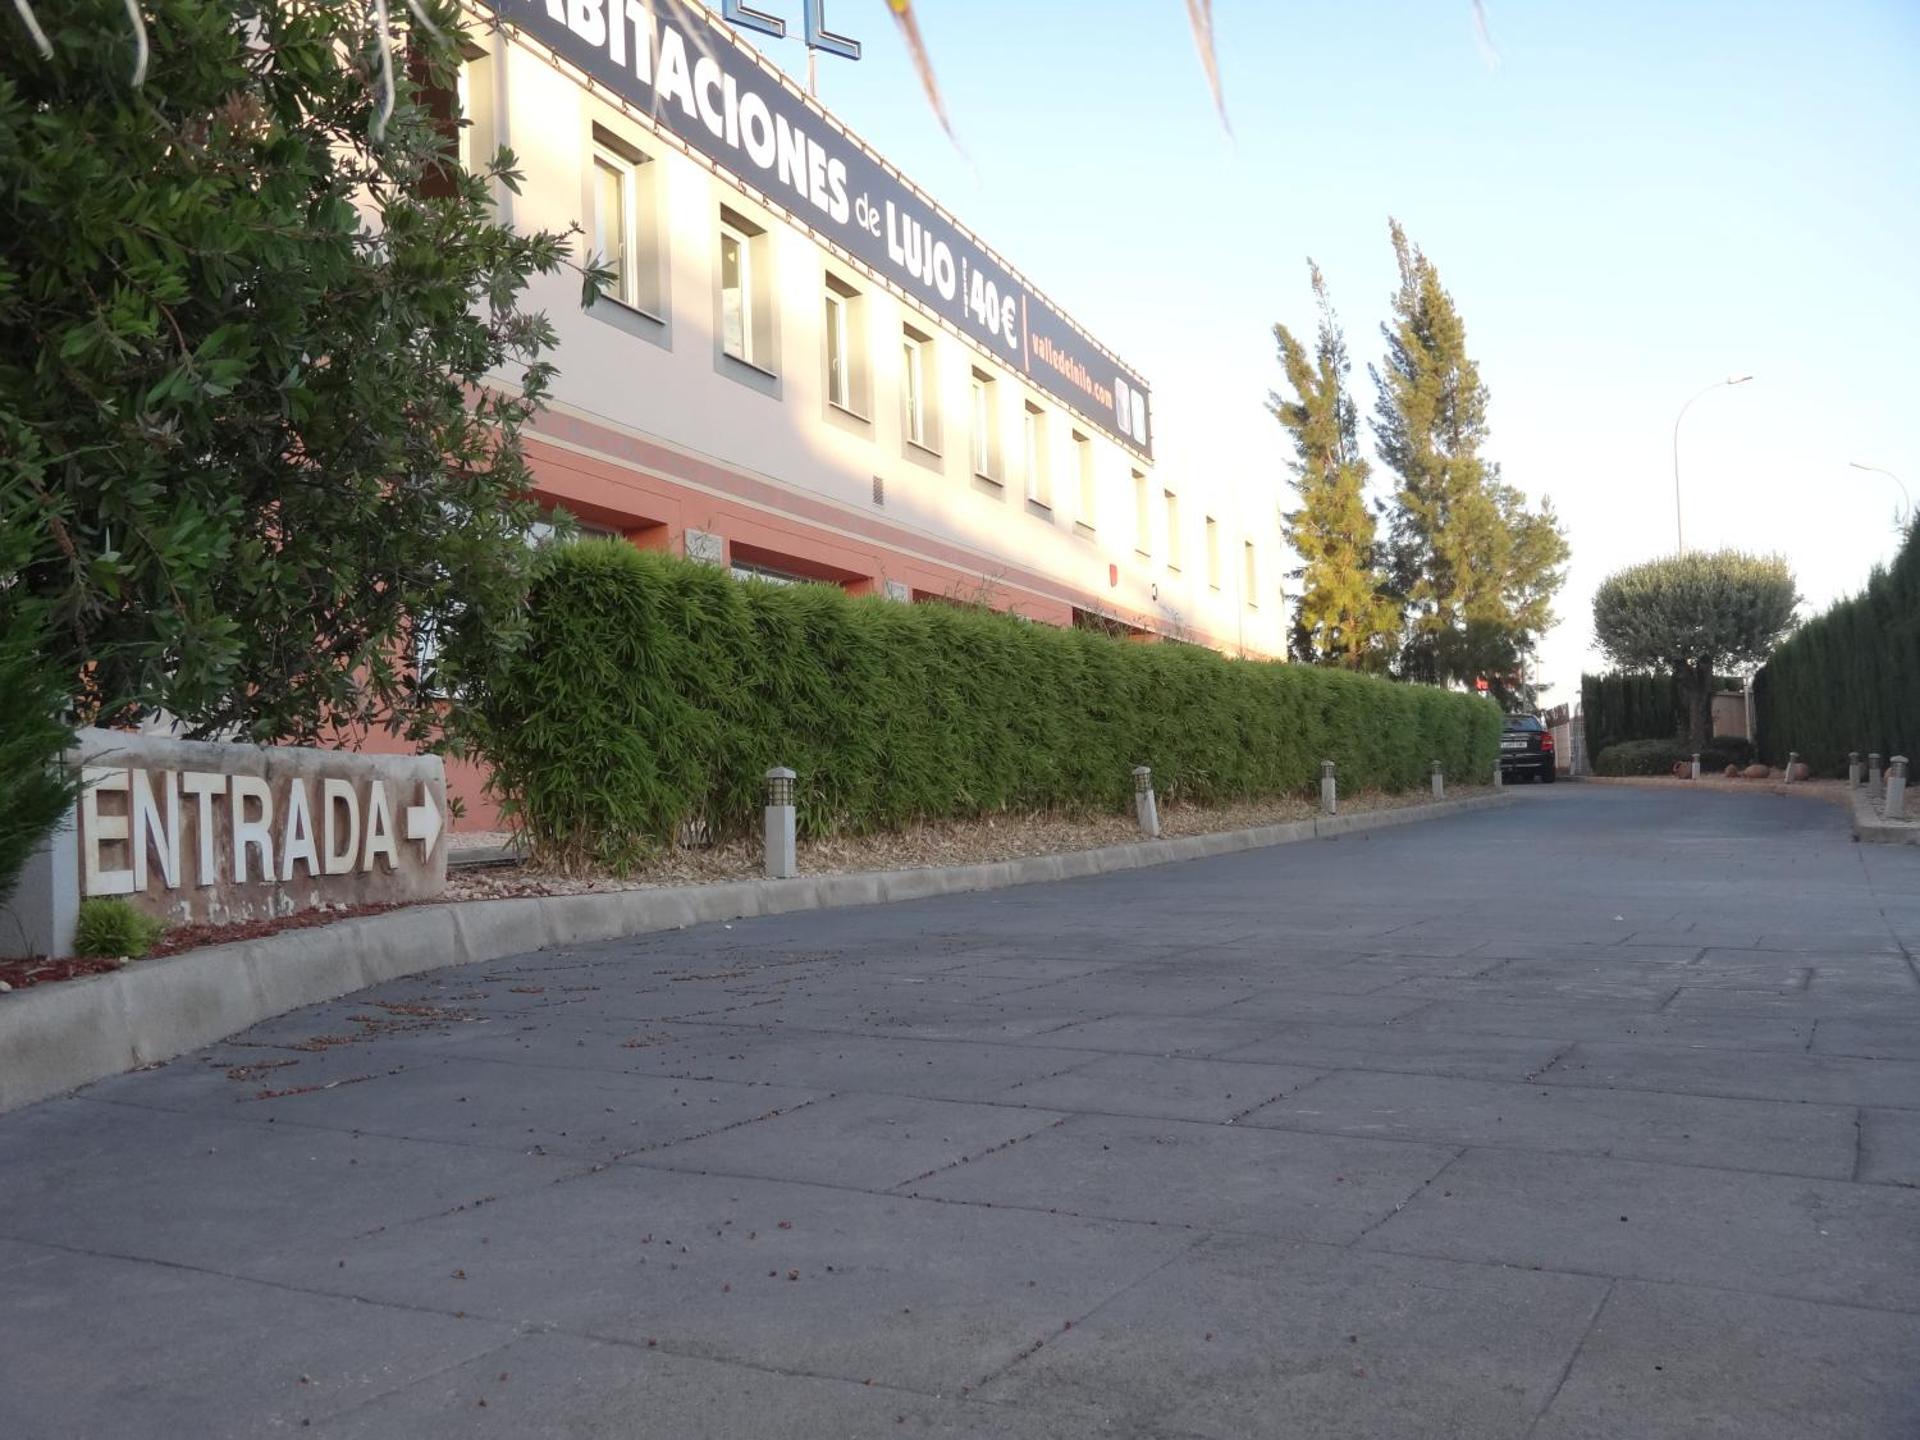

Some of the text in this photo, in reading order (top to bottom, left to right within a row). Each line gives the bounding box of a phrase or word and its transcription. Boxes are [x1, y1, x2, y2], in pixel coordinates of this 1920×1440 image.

[528, 0, 849, 225] BITACIONES
[856, 192, 880, 237] de
[886, 200, 956, 300] LUJO
[970, 269, 1017, 349] 40€
[81, 766, 399, 897] ENTRADA
